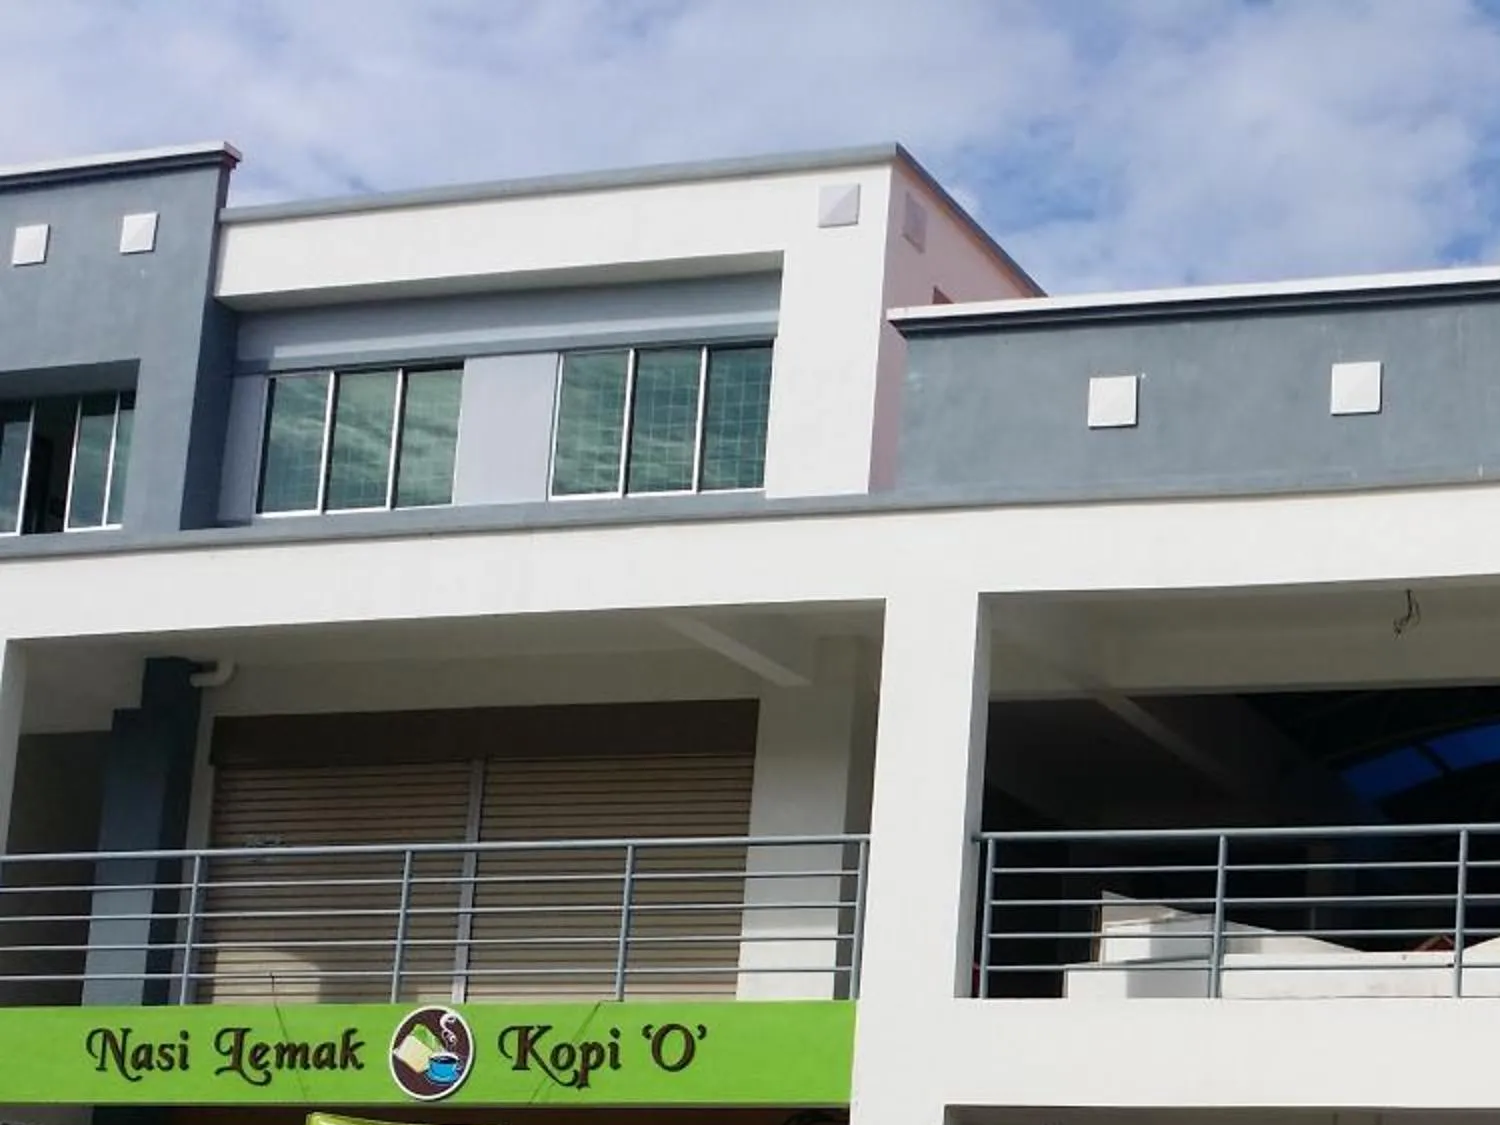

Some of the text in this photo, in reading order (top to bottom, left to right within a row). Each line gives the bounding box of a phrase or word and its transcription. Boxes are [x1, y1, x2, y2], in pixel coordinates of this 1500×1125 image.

[86, 1027, 366, 1087] Nasi Lemak
[498, 1025, 622, 1090] Kopi
